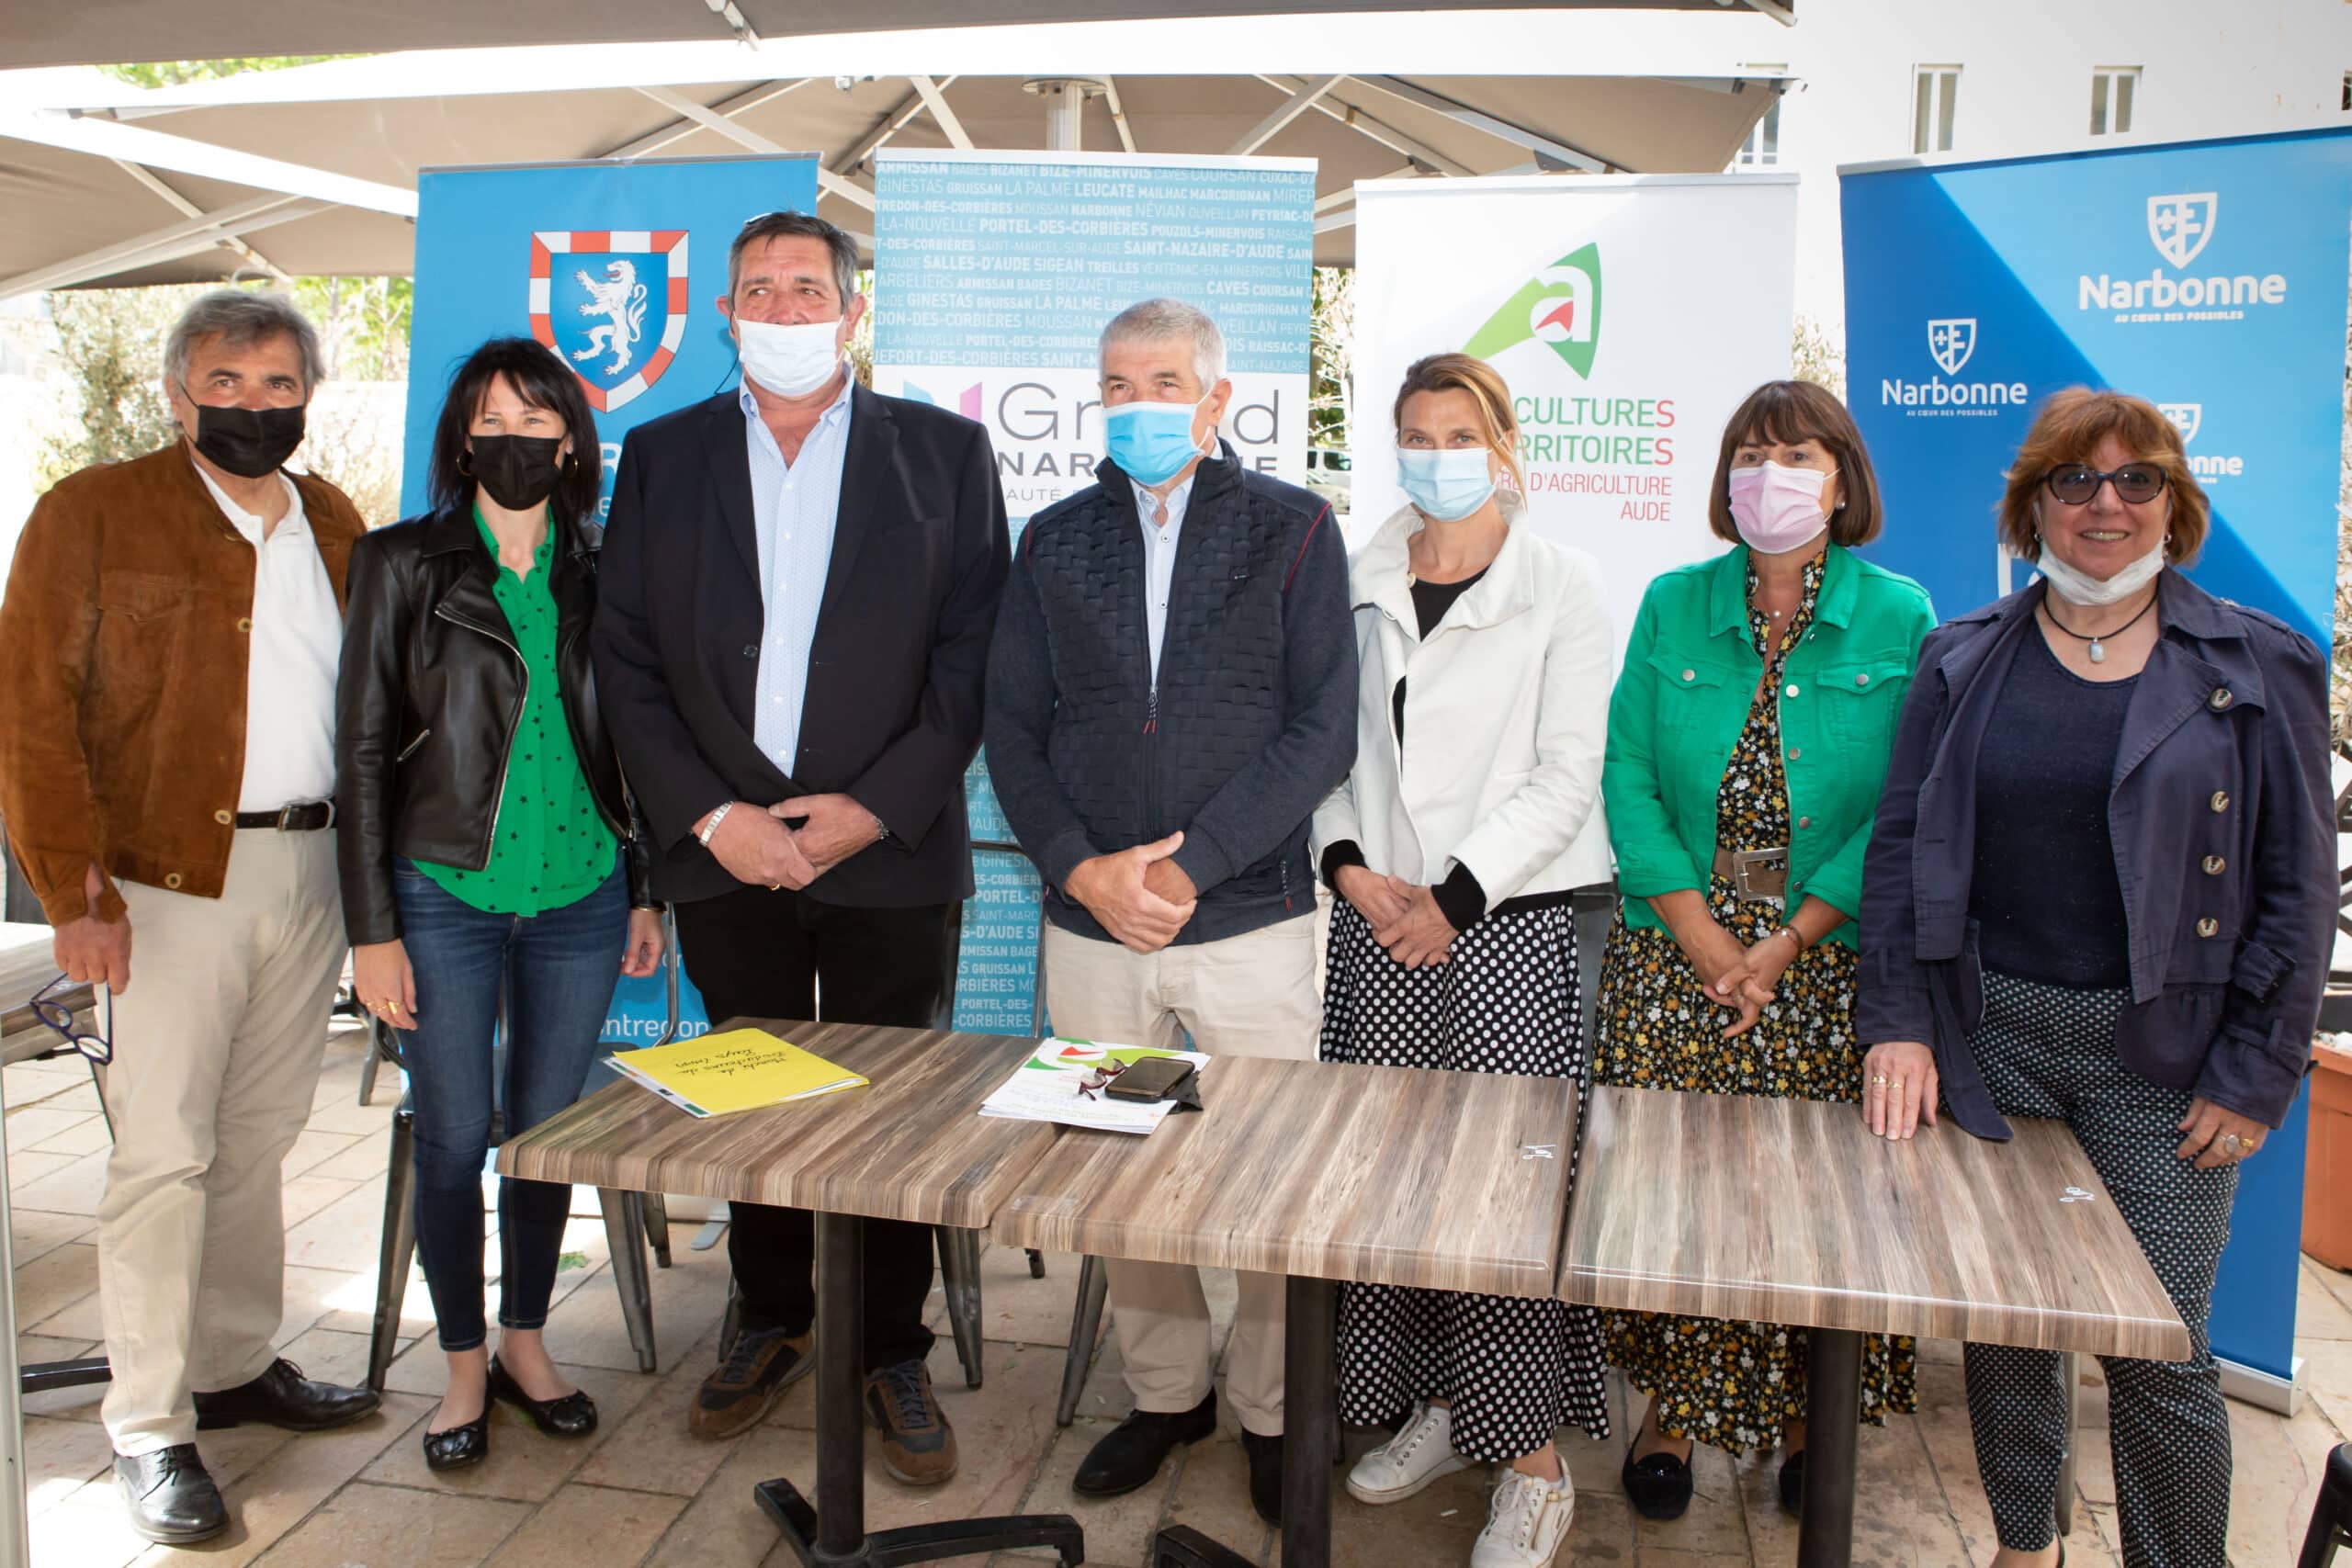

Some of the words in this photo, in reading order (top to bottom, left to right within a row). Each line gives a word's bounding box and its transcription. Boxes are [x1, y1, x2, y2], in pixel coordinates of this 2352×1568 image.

[878, 178, 943, 194] GINESTAS
[947, 182, 1002, 195] GRUISSAN
[1005, 180, 1023, 195] LA
[1025, 181, 1072, 197] PALME
[1074, 182, 1136, 197] LEUCATE
[1138, 186, 1188, 199] MAILHAC
[1191, 188, 1271, 202] MARCORIGNAN
[1015, 202, 1069, 215] MOUSSAN
[1071, 203, 1133, 217] NARBONNE
[1135, 199, 1185, 218] NÉVIAN
[1189, 207, 1250, 220] OUVEILLAN
[979, 217, 1148, 236] PORTEL-DES-CORBIÈRES
[1151, 225, 1265, 240] POUZOLS-MINERVOIS
[876, 235, 976, 251] T-DES-CORBIÈRES
[978, 240, 1124, 255] SAINT-MARCEL-SUR-AUDE
[1124, 241, 1284, 259] SAINT-NAZAIRE-D'AUDE
[922, 254, 1030, 271] SALLES-D'AUDE
[1034, 257, 1083, 272] SIGEAN
[1087, 261, 1139, 274] TREILLES
[1142, 263, 1281, 278] VENTENAC-EN-MINERVOIS
[878, 273, 953, 288] ARGELIERS
[956, 277, 1014, 290] ARMISSAN
[1017, 279, 1052, 290] BAGES
[1056, 276, 1111, 293] BIZANET
[1116, 279, 1205, 295] BIZE-MINERVOIS
[1206, 280, 1250, 295] CAVES
[1252, 284, 1304, 297] COURSAN
[2079, 268, 2287, 310] Narbonne
[907, 292, 974, 308] GINESTAS
[977, 296, 1032, 309] GRUISSAN
[1035, 295, 1052, 310] LA
[1056, 295, 1102, 310] PALME
[1219, 303, 1299, 316] MARCORIGNAN
[876, 308, 1021, 329] DON-DES-CORBIÈRES
[1025, 314, 1091, 329] MOUSSAN
[2115, 313, 2129, 323] AU
[2164, 311, 2184, 321] DES
[2187, 310, 2245, 321] POSSIBLES
[1882, 375, 2029, 406] Narbonne
[1531, 472, 1672, 496] D'AGRICULTURE
[1620, 501, 1670, 521] AUDE
[971, 962, 1026, 975] GRUISSAN
[956, 975, 1015, 992] RBIÈRES
